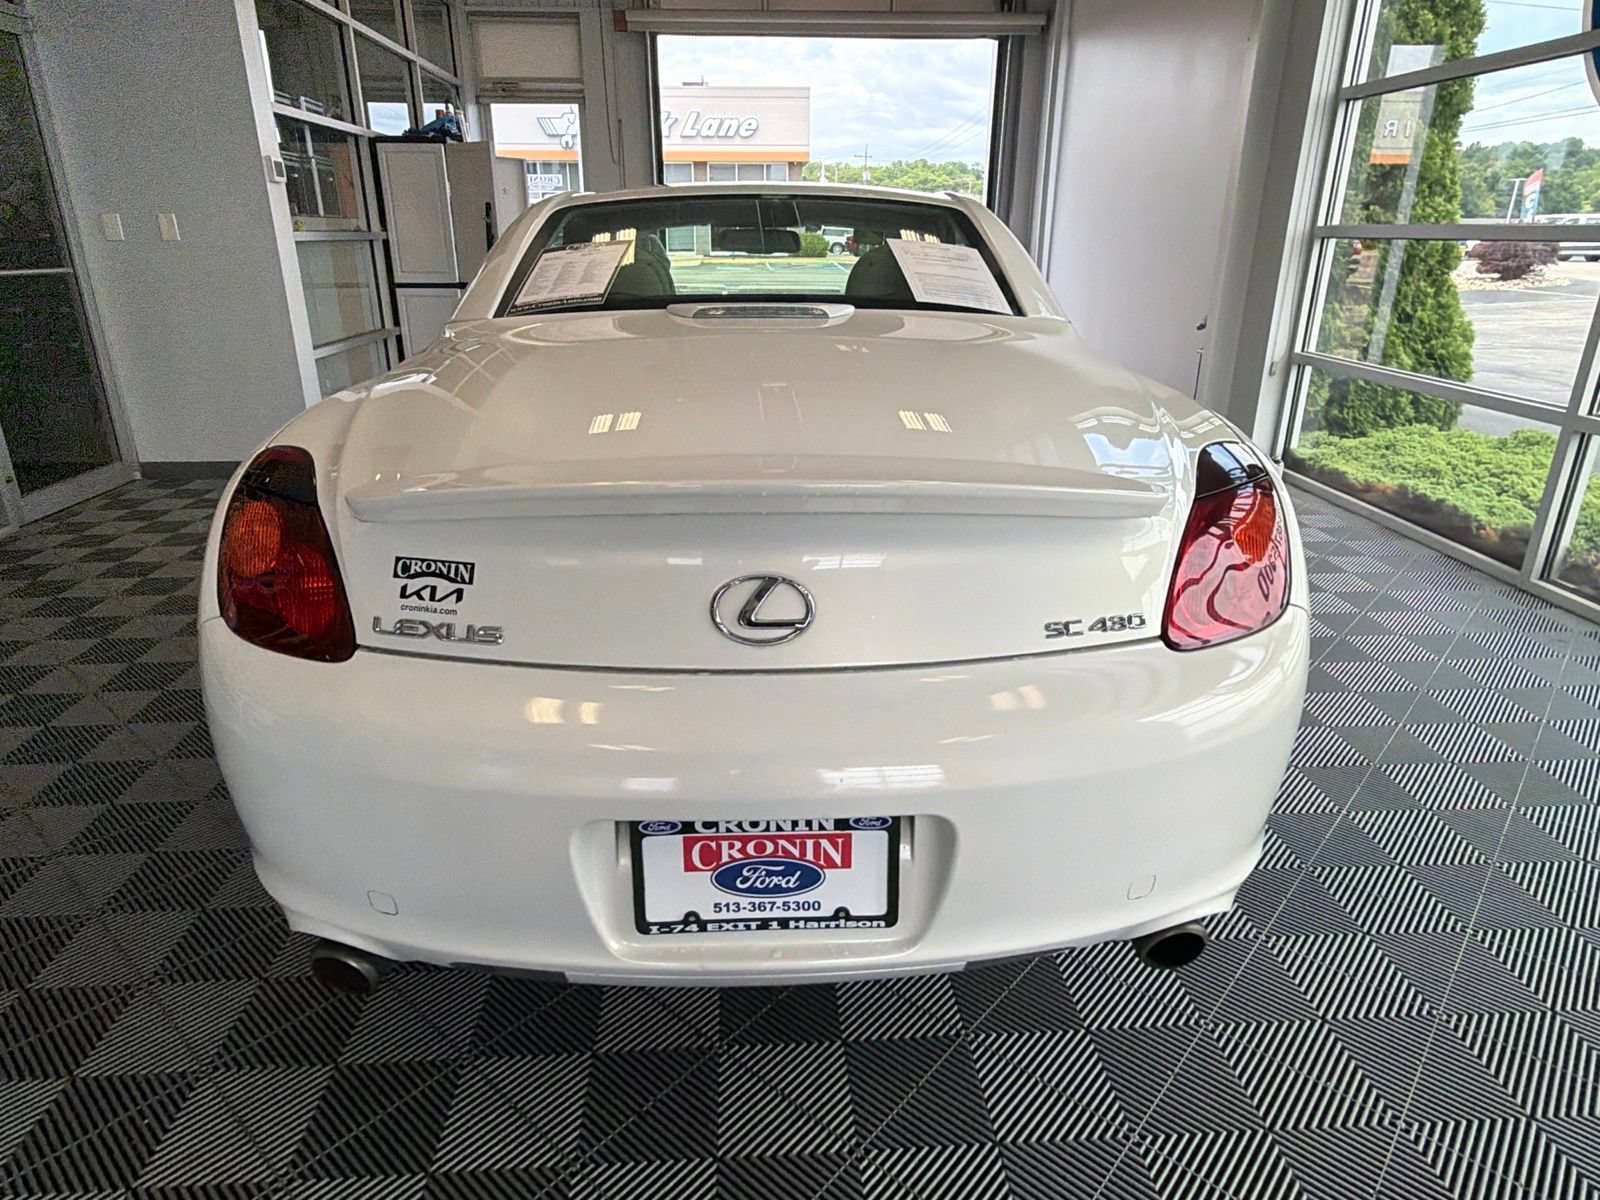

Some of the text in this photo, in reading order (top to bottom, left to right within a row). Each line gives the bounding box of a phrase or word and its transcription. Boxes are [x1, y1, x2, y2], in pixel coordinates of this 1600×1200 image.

[680, 111, 759, 139] Lane
[396, 558, 472, 583] CRONIN
[399, 583, 464, 605] KIA
[400, 603, 458, 616] croninkia.com
[372, 616, 505, 646] LEXUS
[1043, 619, 1084, 639] SC
[647, 822, 672, 832] Ford
[694, 817, 835, 833] CRONIN
[691, 838, 845, 870] CRONIN
[735, 864, 802, 889] Ford
[713, 900, 821, 913] 513-367-5300
[649, 919, 886, 935] I-74 EXIT 1 Harrison
